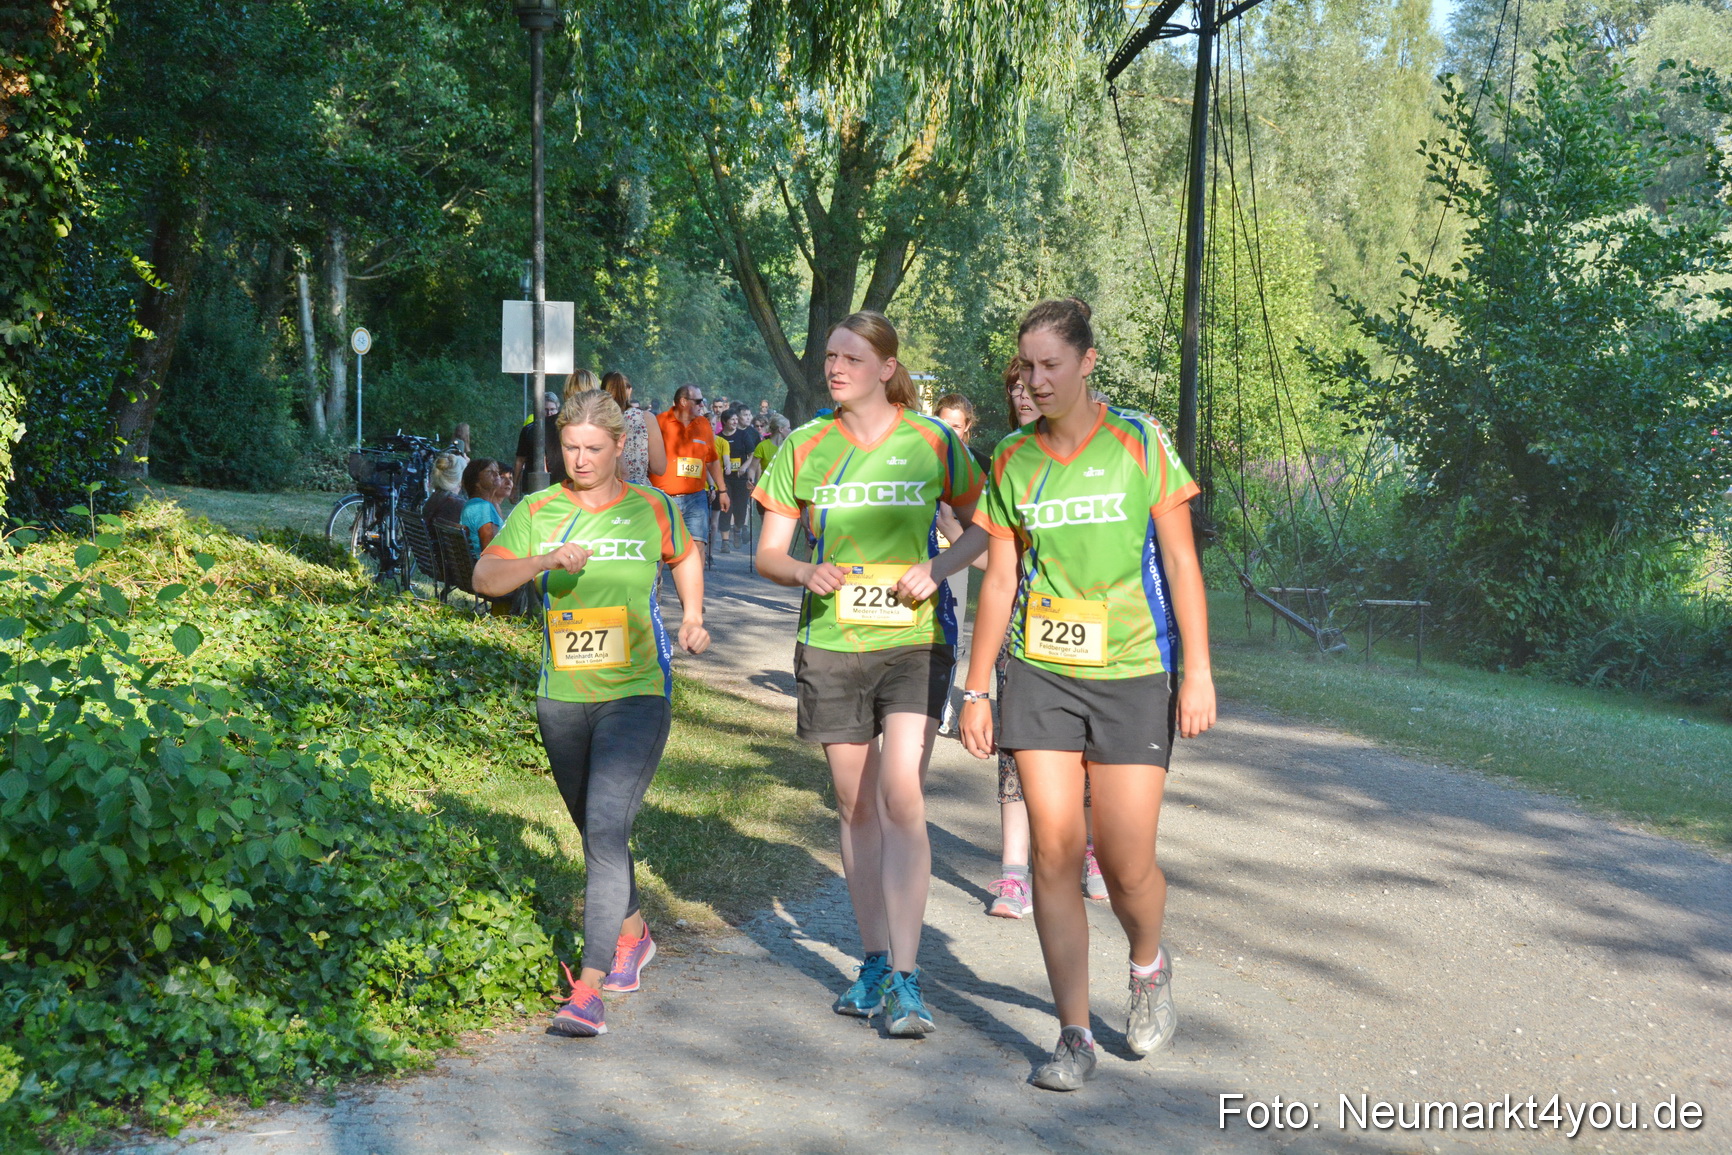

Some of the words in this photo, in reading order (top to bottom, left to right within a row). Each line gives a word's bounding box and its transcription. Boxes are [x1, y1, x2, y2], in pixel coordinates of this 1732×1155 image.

[681, 464, 699, 473] 1487
[812, 481, 926, 509] BOCK
[1015, 493, 1128, 530] BOCK
[853, 586, 899, 608] 228
[565, 629, 609, 653] 227
[1040, 619, 1086, 646] 229
[594, 652, 609, 660] Anja
[1039, 642, 1071, 653] Feldberger
